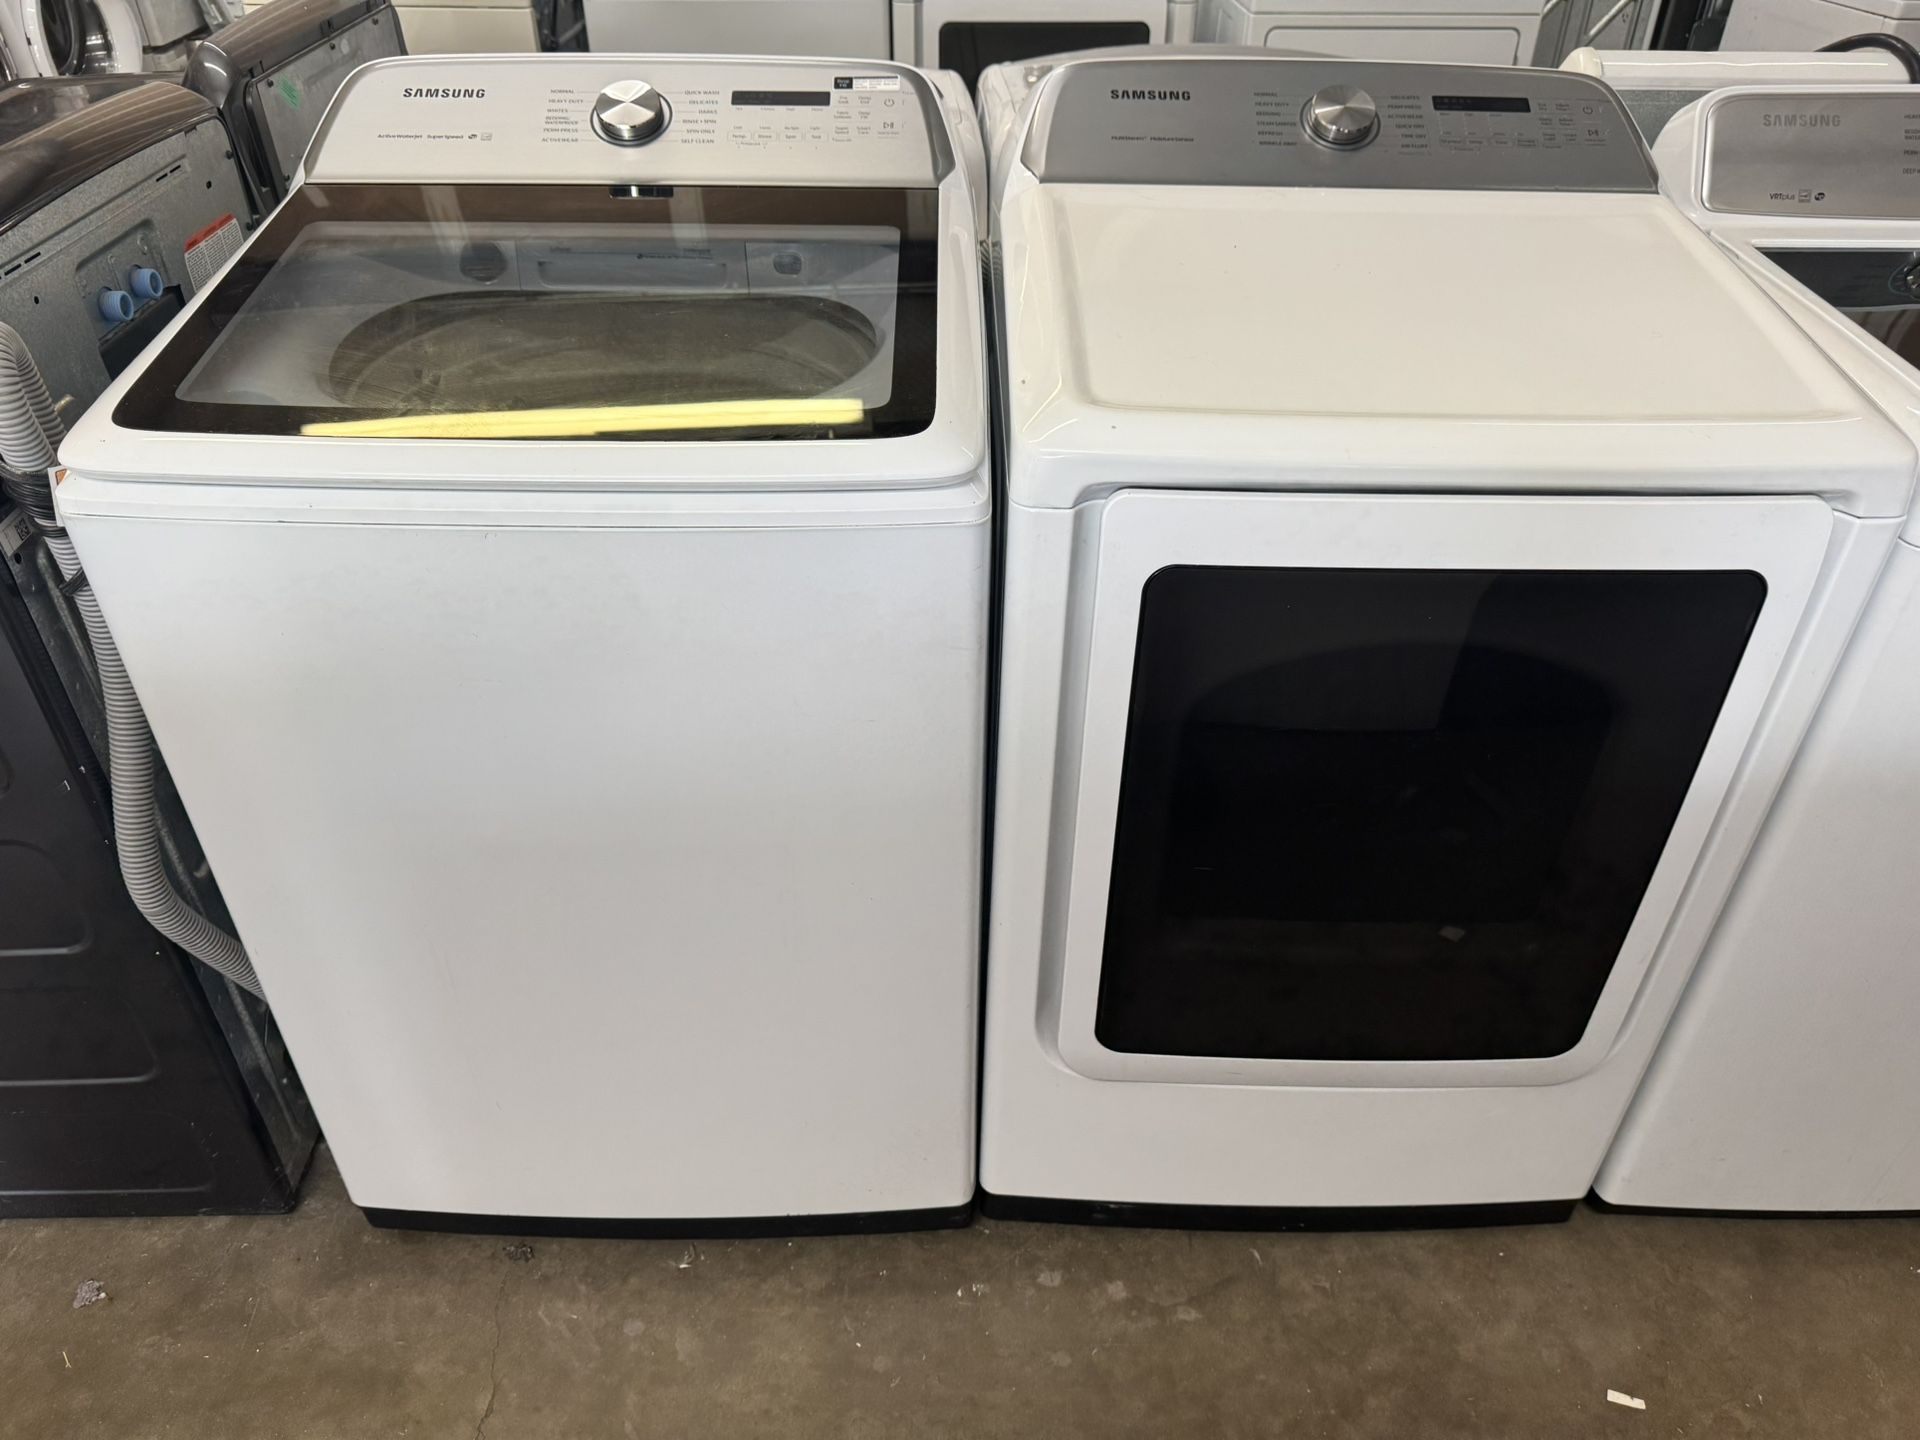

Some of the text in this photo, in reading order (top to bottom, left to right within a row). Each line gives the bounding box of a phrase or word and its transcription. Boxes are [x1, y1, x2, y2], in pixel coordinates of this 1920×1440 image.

[403, 87, 486, 99] SAMSUNG
[1110, 89, 1191, 101] SAMSUNG
[1762, 114, 1841, 128] SAMSUNG
